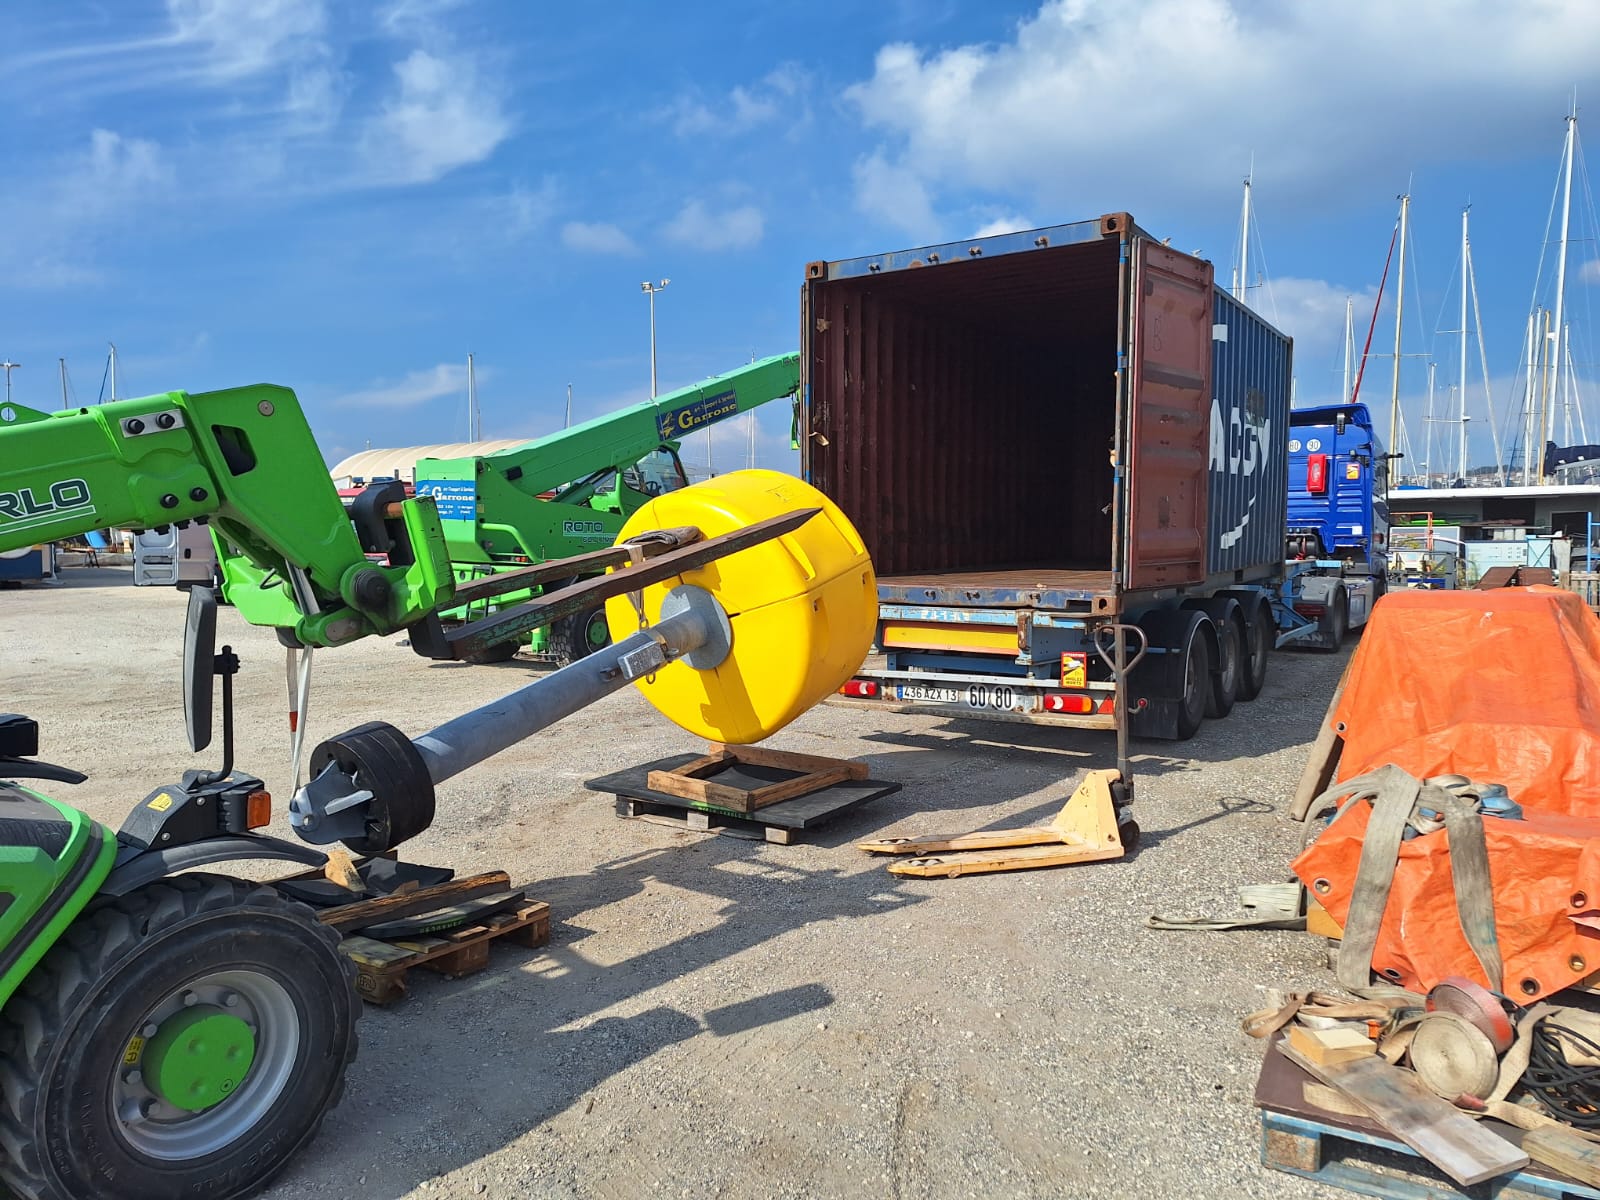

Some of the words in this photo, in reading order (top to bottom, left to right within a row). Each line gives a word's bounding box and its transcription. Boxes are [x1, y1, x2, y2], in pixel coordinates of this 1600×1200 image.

[678, 403, 737, 429] Garrone
[1308, 440, 1319, 450] 90
[432, 486, 475, 500] Garrone
[564, 521, 604, 532] ROTO
[904, 687, 922, 698] 436
[924, 688, 942, 700] AZX
[945, 690, 957, 701] 13
[969, 685, 986, 707] 60
[995, 687, 1012, 709] 80
